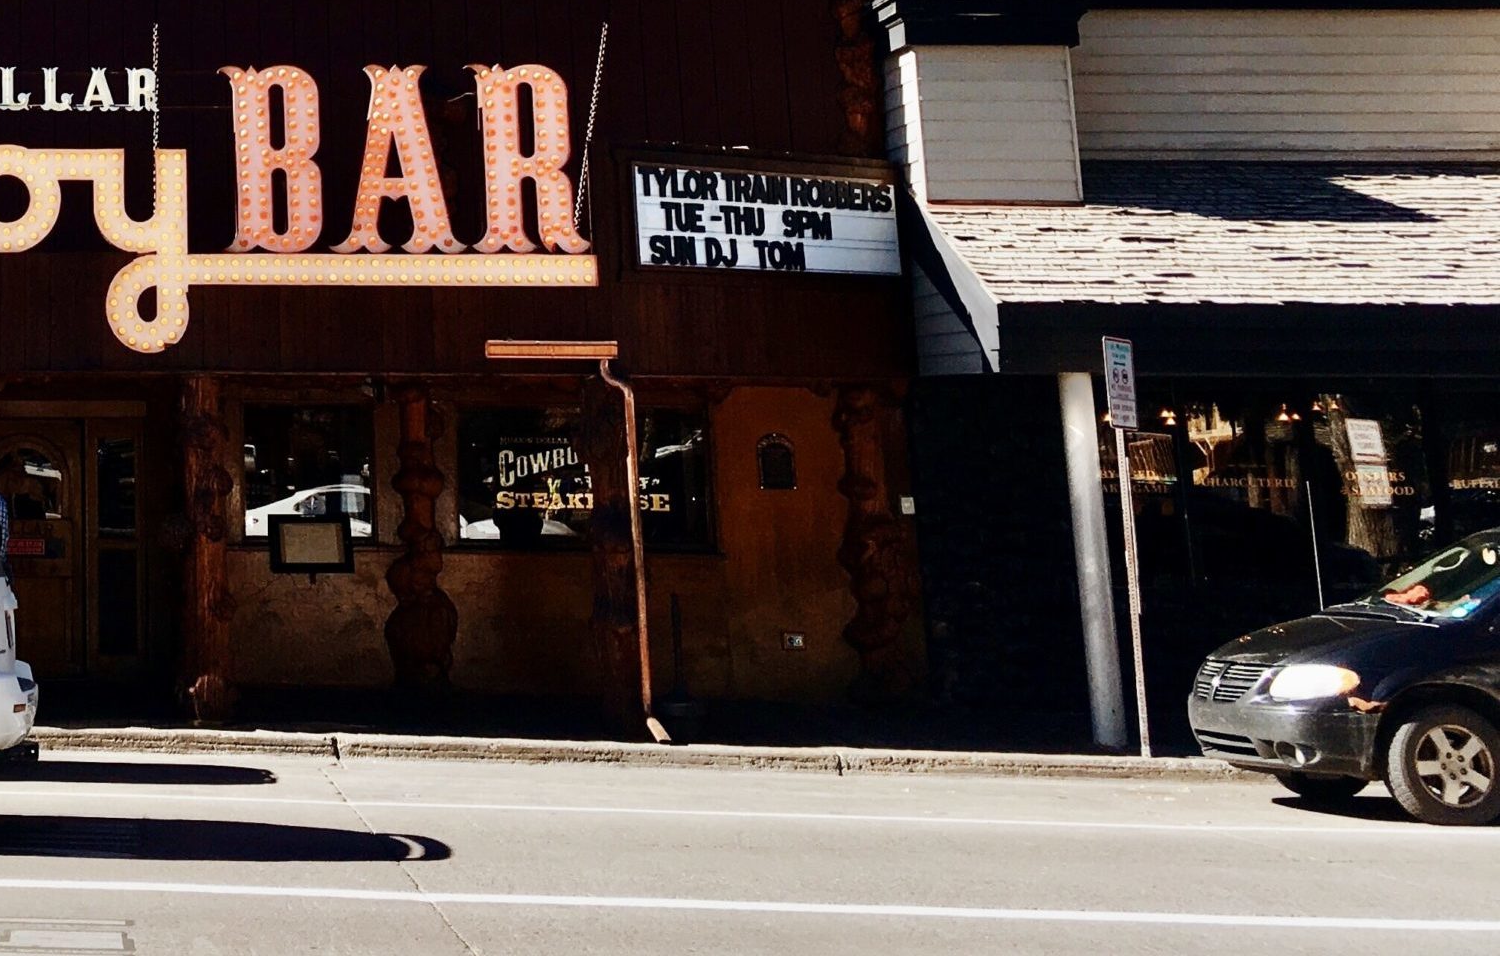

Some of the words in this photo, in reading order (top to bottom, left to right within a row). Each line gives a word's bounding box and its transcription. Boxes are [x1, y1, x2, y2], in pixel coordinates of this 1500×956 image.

[217, 64, 592, 254] BAR
[638, 166, 718, 201] TYLOR
[721, 172, 788, 206] TRAIN
[791, 179, 893, 213] ROBBERS
[660, 201, 706, 233] TUE
[781, 210, 833, 241] 9PM
[649, 236, 697, 266] SUN
[705, 238, 739, 268] DJ
[754, 240, 807, 271] TOM
[498, 446, 593, 487] COWBO
